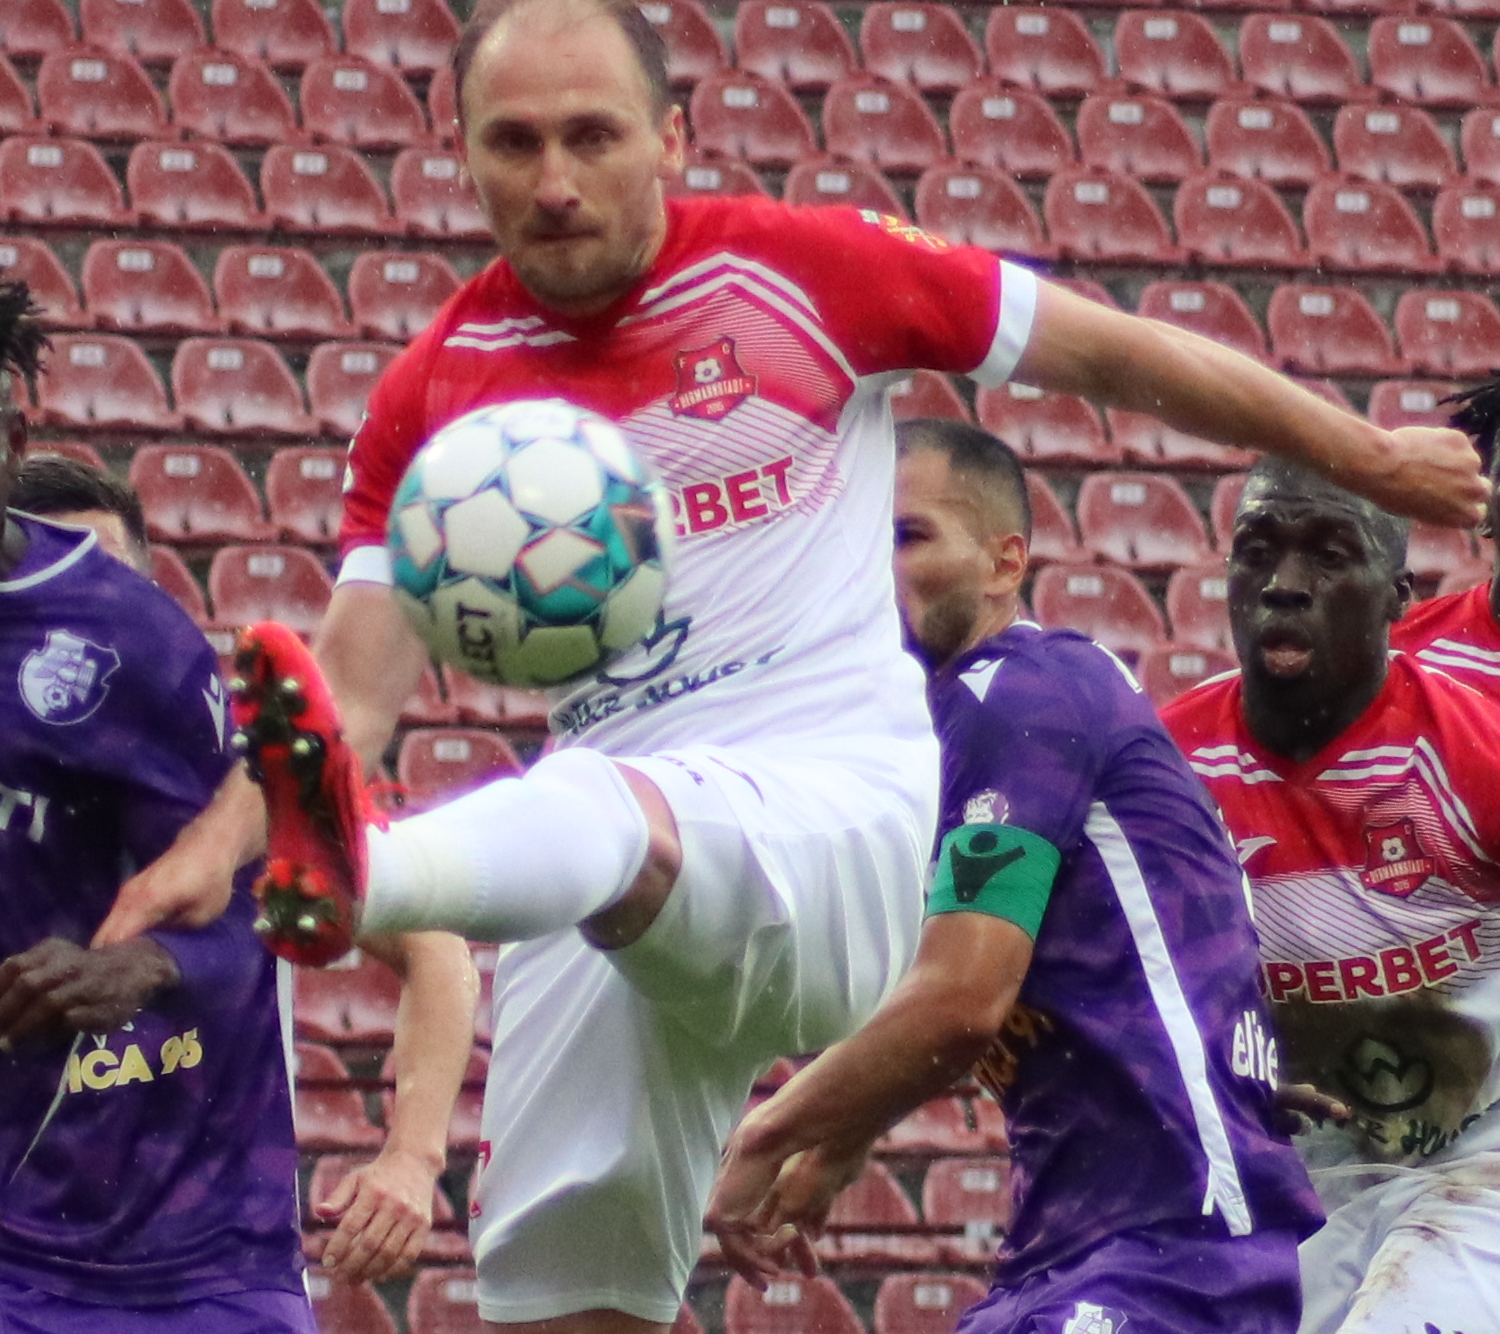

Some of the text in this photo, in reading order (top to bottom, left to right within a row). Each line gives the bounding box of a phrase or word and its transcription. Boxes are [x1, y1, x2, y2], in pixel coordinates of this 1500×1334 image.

[1258, 918, 1483, 1004] PERBET
[66, 1028, 204, 1094] ICA 95
[1231, 1010, 1279, 1092] elite
